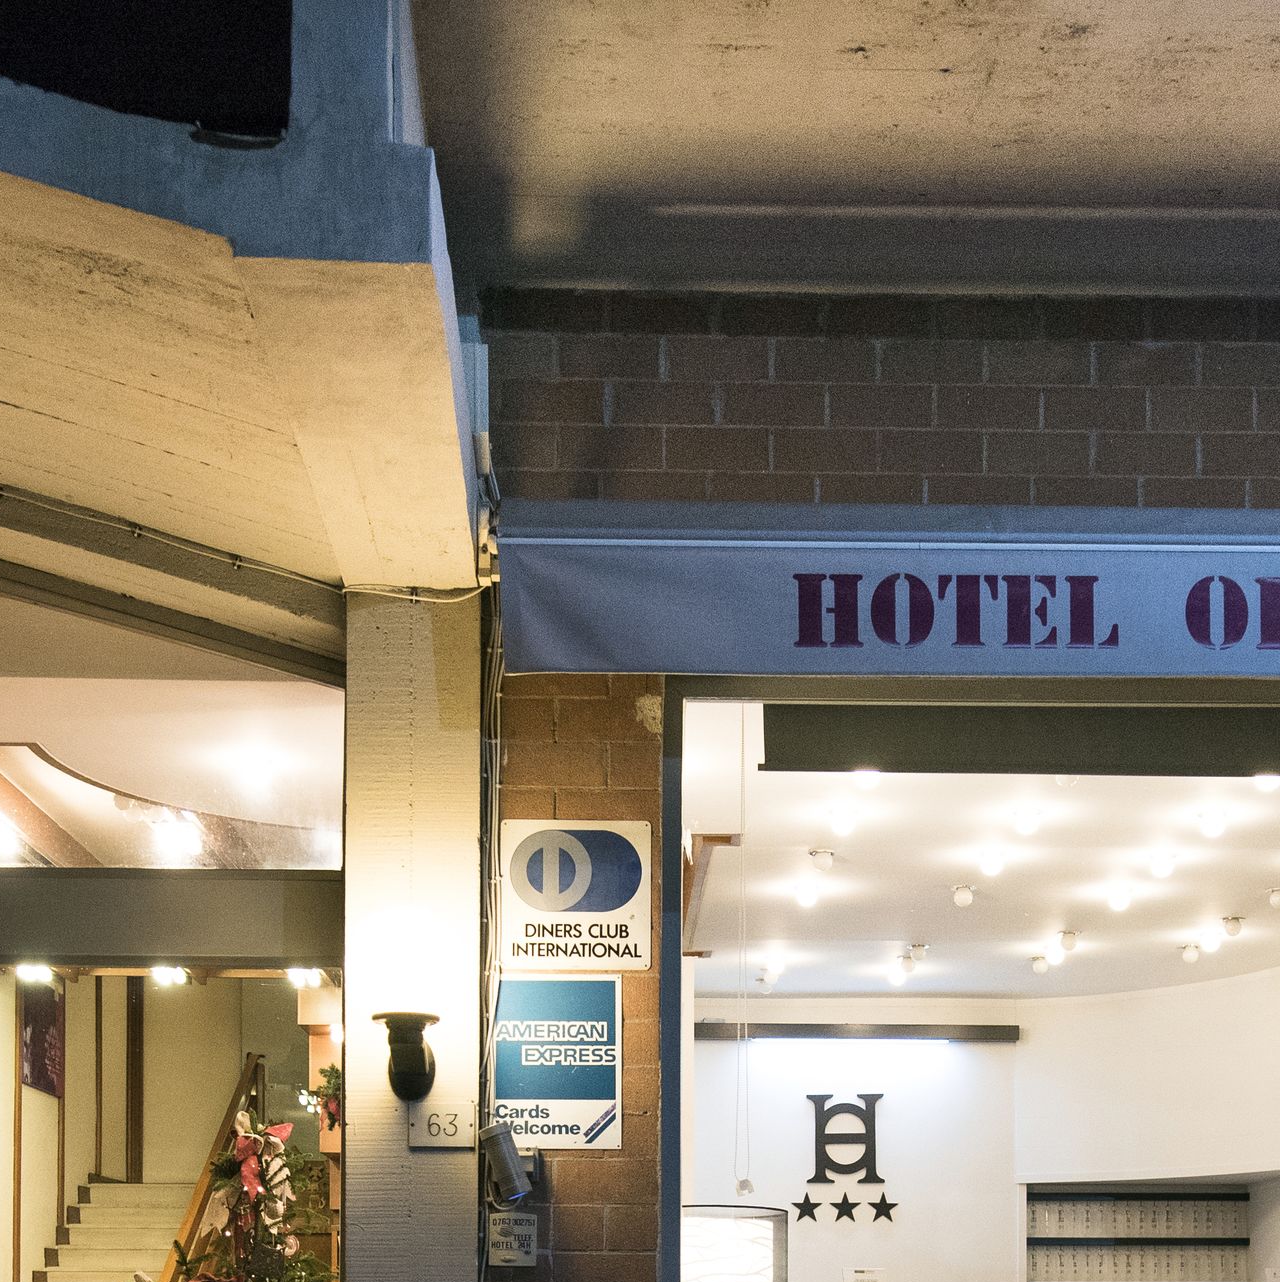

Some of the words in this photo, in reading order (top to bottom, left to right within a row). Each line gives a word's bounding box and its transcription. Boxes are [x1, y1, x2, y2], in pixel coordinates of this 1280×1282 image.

[792, 572, 1120, 649] HOTEL
[525, 923, 582, 938] DINERS
[588, 923, 630, 939] CLUB
[512, 942, 642, 958] INTERNATIONAL
[496, 1023, 606, 1039] AMERICAN
[524, 1047, 616, 1063] EXPRESS
[495, 1104, 550, 1119] Cards
[427, 1113, 458, 1137] 63
[491, 1241, 513, 1249] HOTEL
